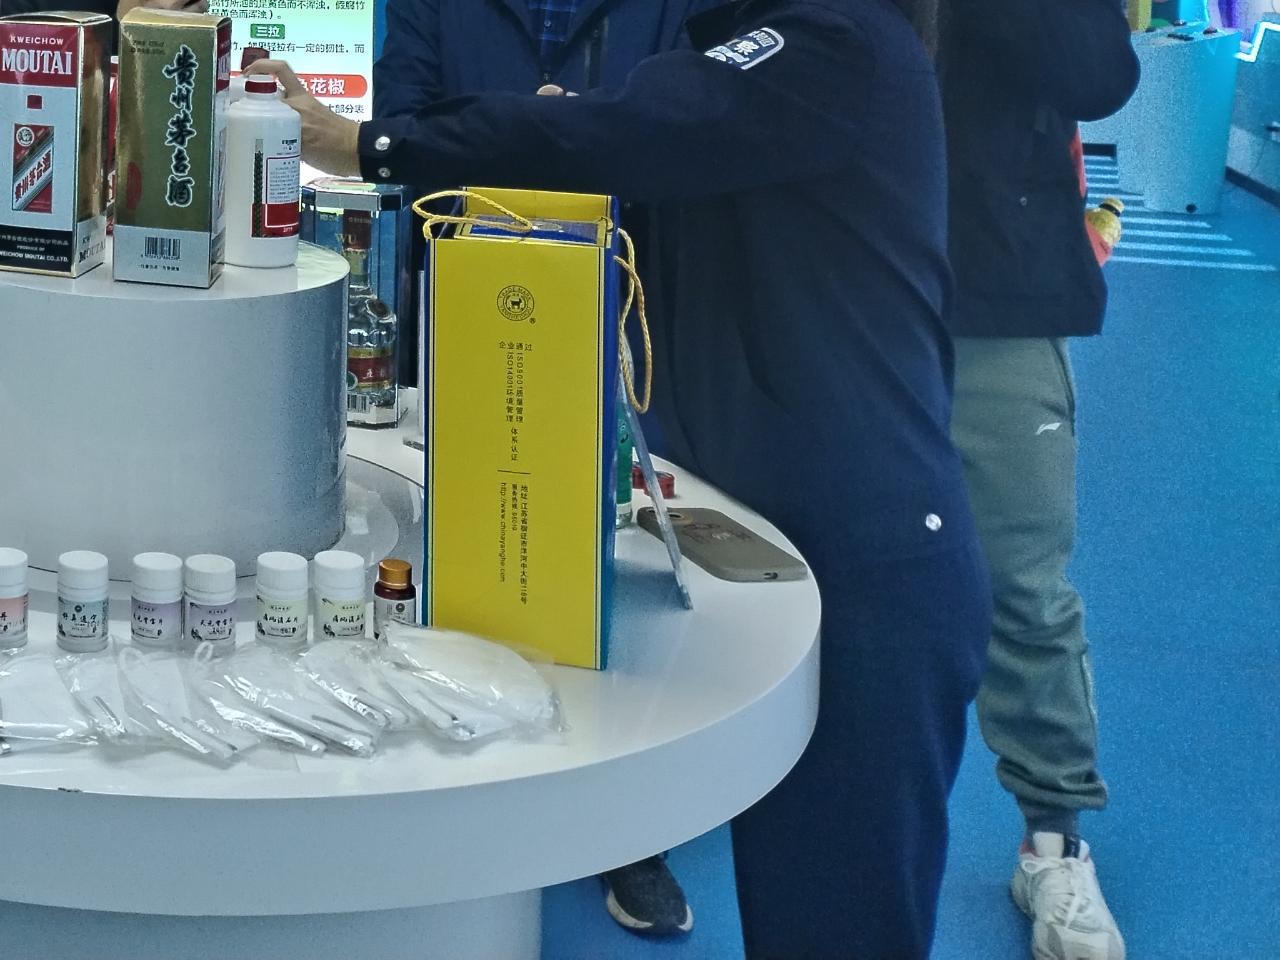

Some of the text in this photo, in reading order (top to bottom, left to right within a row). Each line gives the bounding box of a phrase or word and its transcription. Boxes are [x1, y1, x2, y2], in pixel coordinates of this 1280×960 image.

[9, 34, 64, 46] KWEICHOW
[256, 26, 281, 37] 三拉
[1, 48, 73, 75] MOUTAI
[162, 43, 198, 208] 贵州茅台酒
